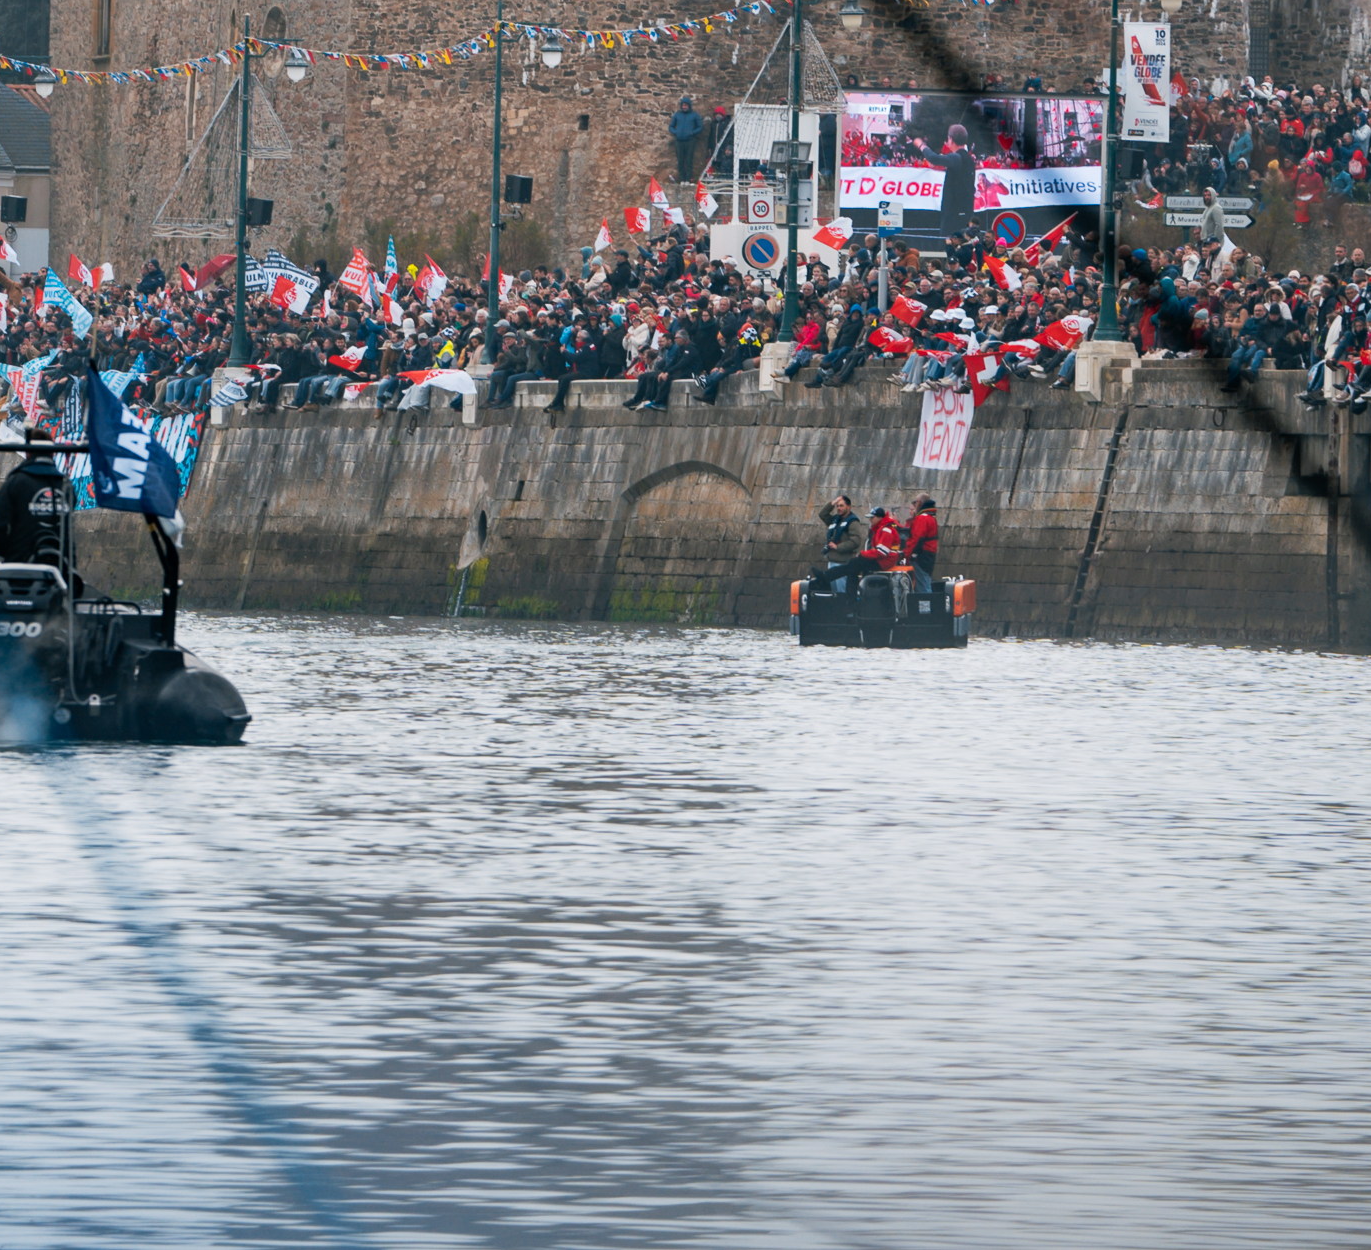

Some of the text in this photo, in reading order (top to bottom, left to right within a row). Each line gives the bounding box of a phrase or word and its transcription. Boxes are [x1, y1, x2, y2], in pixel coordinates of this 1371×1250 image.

[1155, 30, 1166, 38] 10
[1130, 54, 1166, 66] VENDÉE
[1134, 67, 1162, 79] GLOBE
[756, 205, 767, 213] 30
[934, 384, 965, 417] BON
